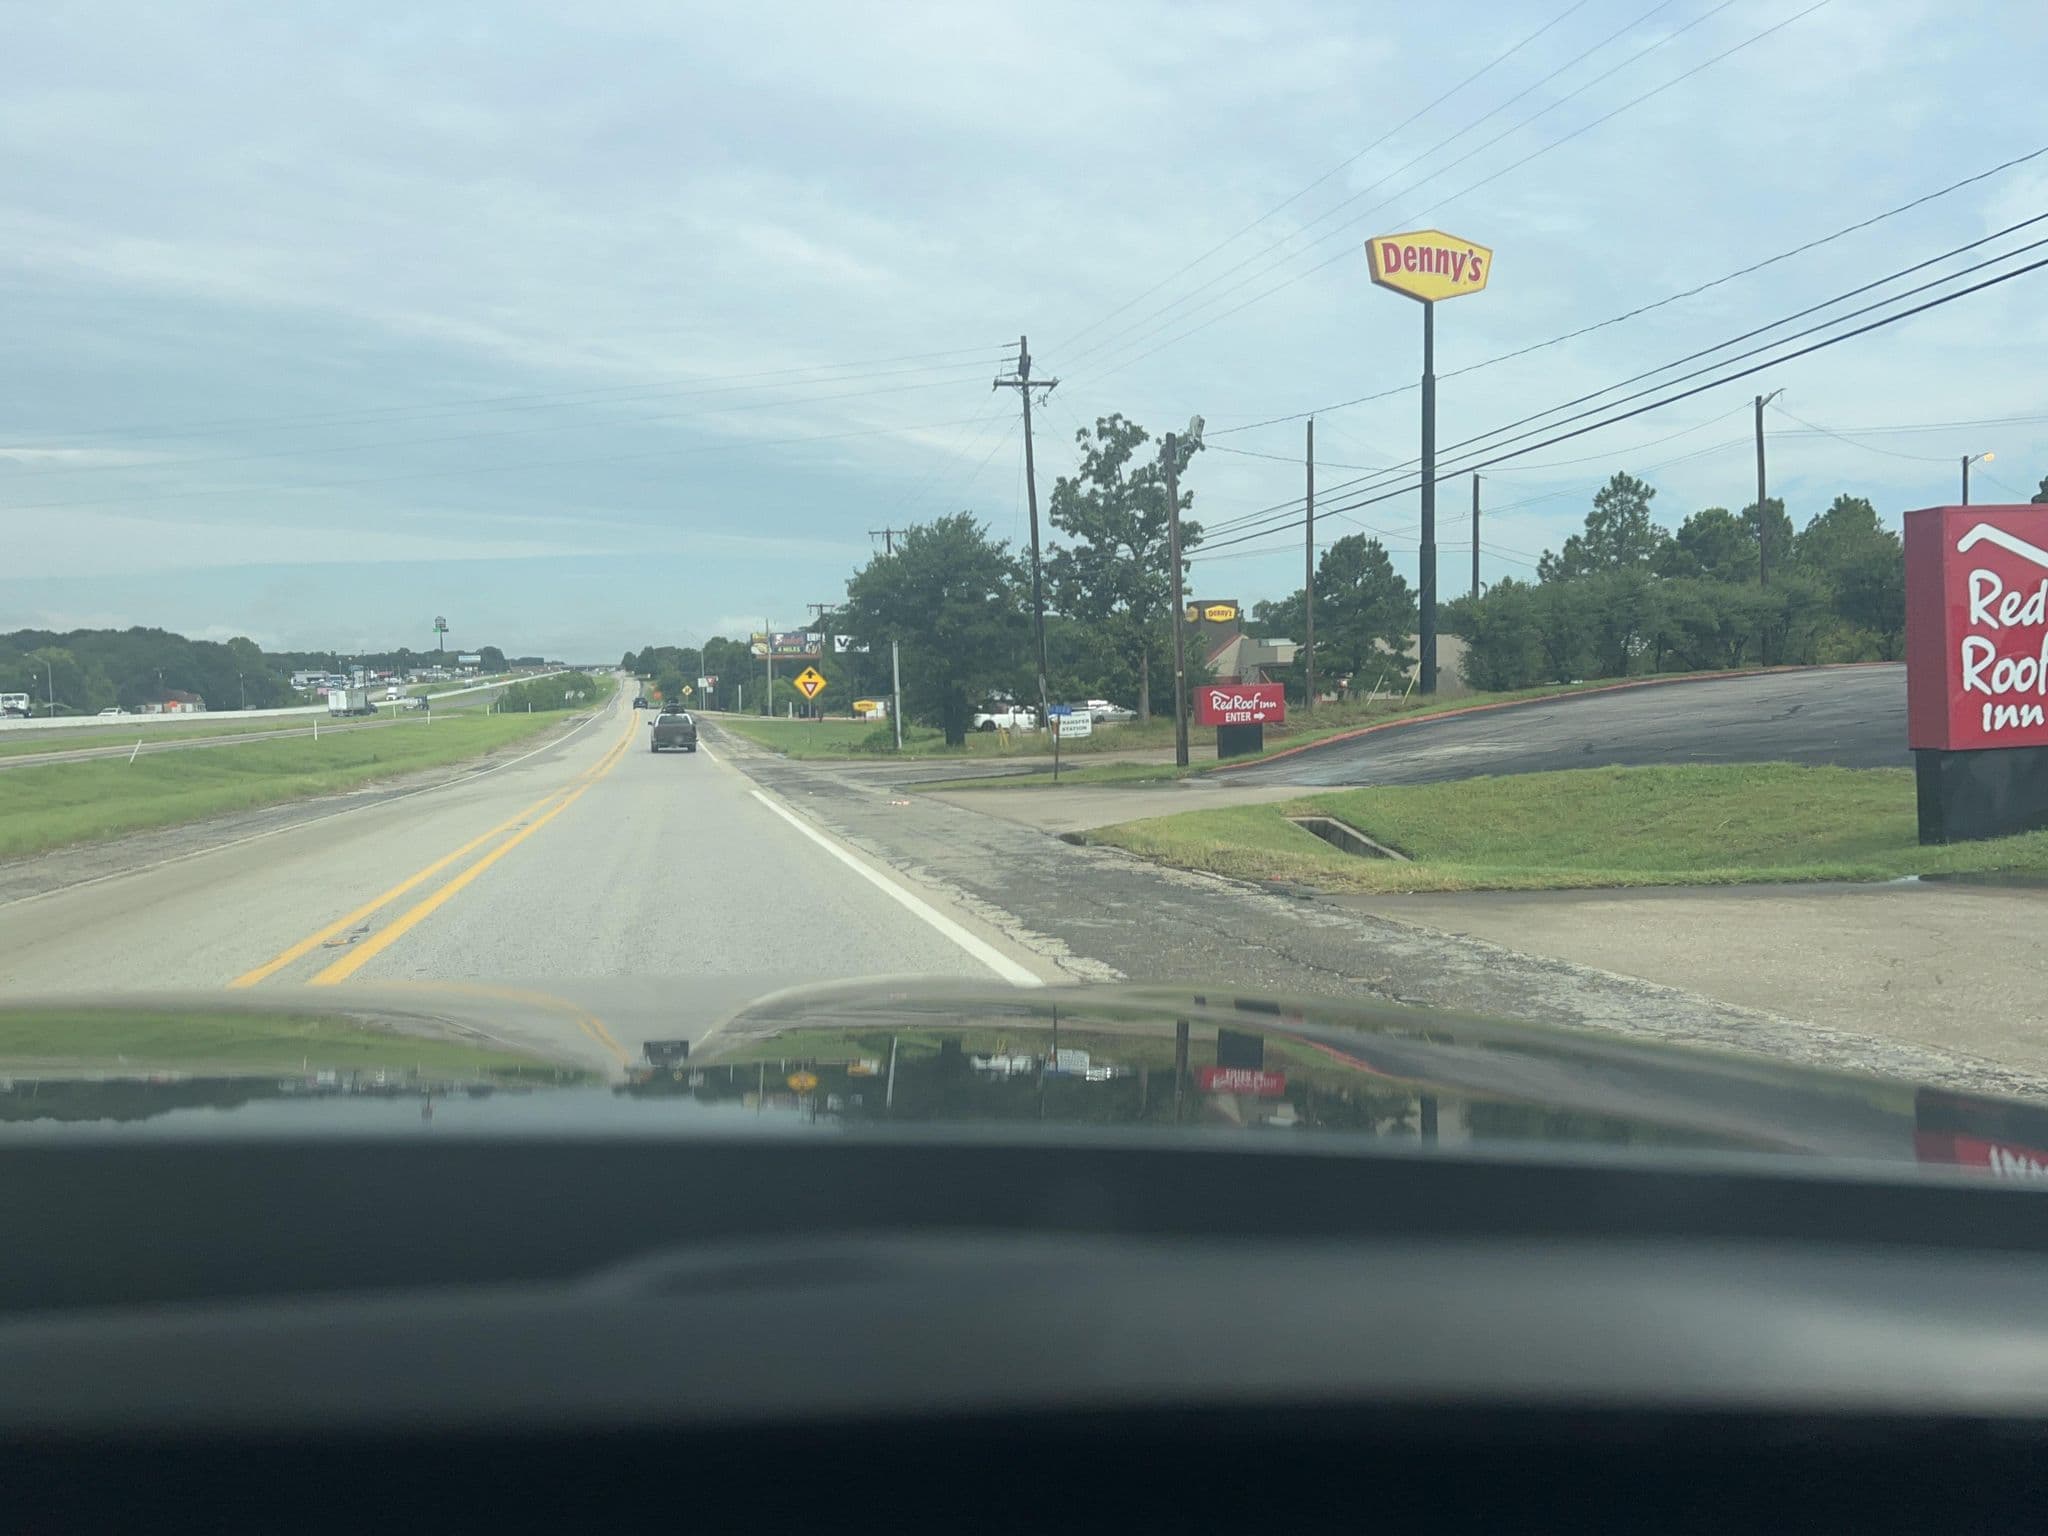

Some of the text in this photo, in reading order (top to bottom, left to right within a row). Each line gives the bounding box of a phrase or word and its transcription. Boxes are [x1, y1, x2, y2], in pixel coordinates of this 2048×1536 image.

[1382, 242, 1483, 282] Denny's
[1969, 569, 2048, 629] Red
[1212, 695, 1233, 710] Red
[1233, 693, 1261, 710] Roof
[1225, 712, 1251, 722] ENTER
